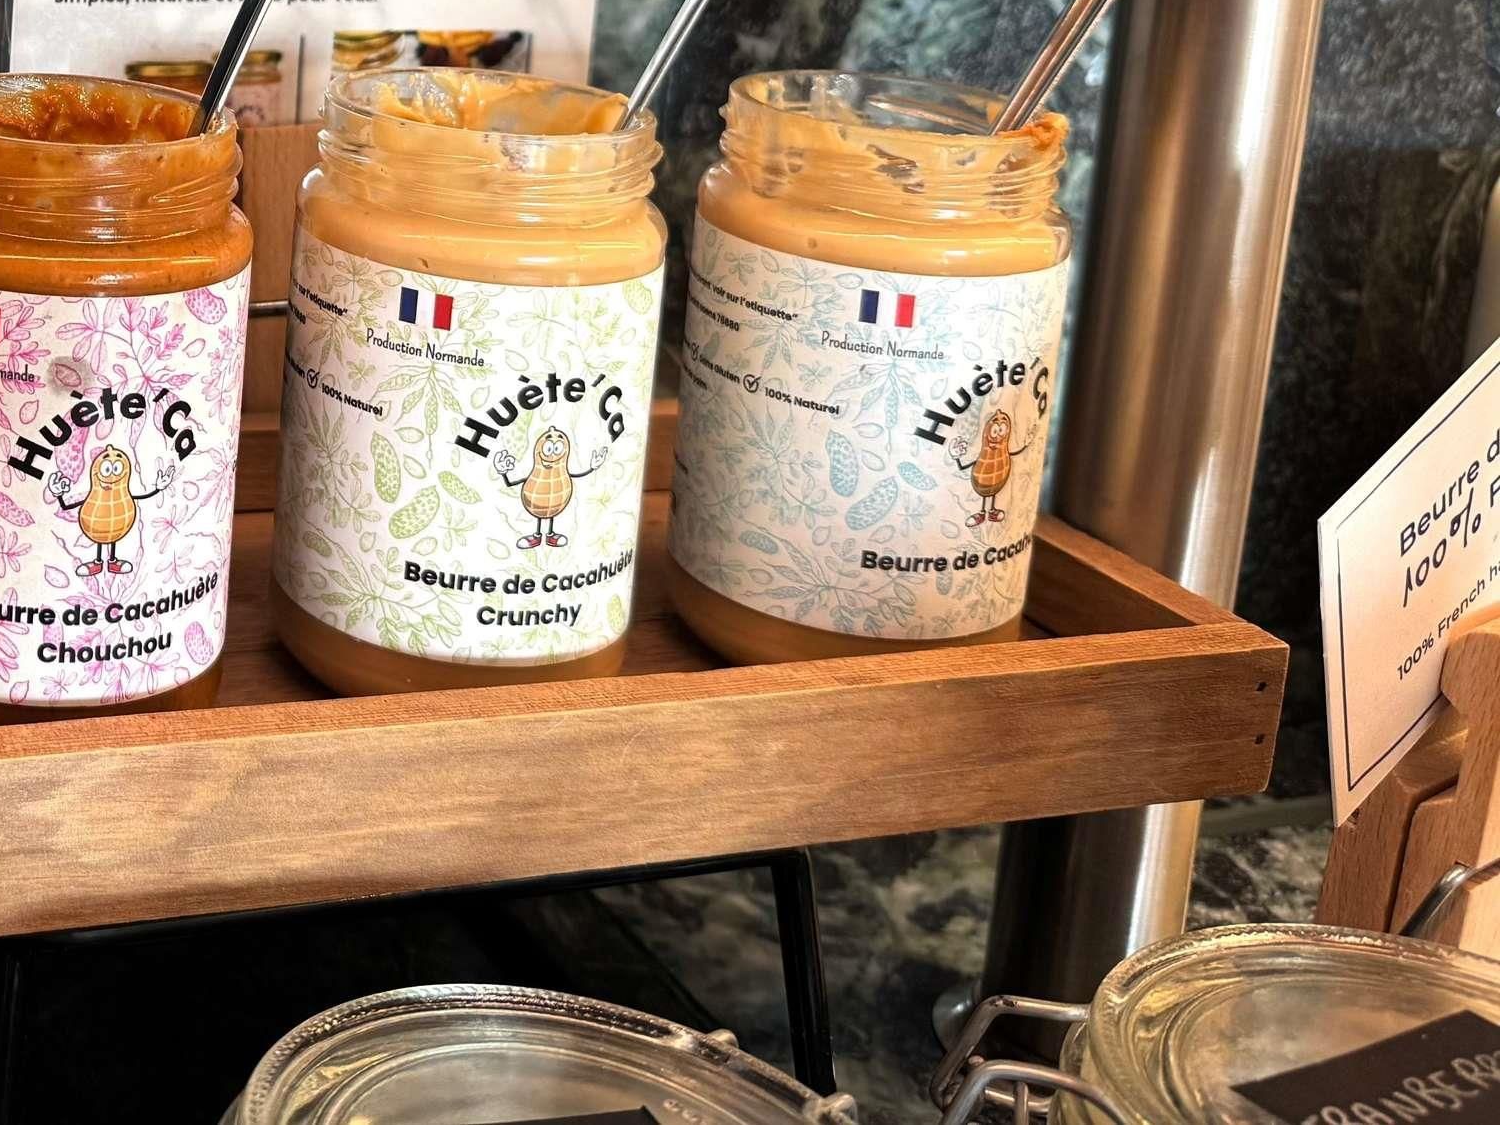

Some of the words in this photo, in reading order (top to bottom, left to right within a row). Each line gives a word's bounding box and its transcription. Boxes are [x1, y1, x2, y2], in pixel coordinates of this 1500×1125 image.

[367, 329, 422, 357] Production
[426, 343, 484, 367] Normande
[822, 330, 882, 355] Production
[887, 341, 944, 361] Normande
[322, 383, 343, 403] 100%
[344, 396, 382, 417] Naturel
[765, 387, 792, 403] 100%
[794, 396, 839, 415] Naturel
[1401, 460, 1479, 557] Beurre
[861, 550, 946, 573] Beurre
[953, 551, 978, 570] de
[1403, 487, 1481, 608] 100%
[404, 561, 496, 593] Beurre
[503, 575, 535, 594] de
[63, 606, 97, 625] de
[105, 572, 218, 622] Cacahuète
[477, 604, 581, 626] Crunchy
[1398, 634, 1434, 680] 100%
[1438, 578, 1485, 638] French
[38, 631, 171, 664] Chouchou
